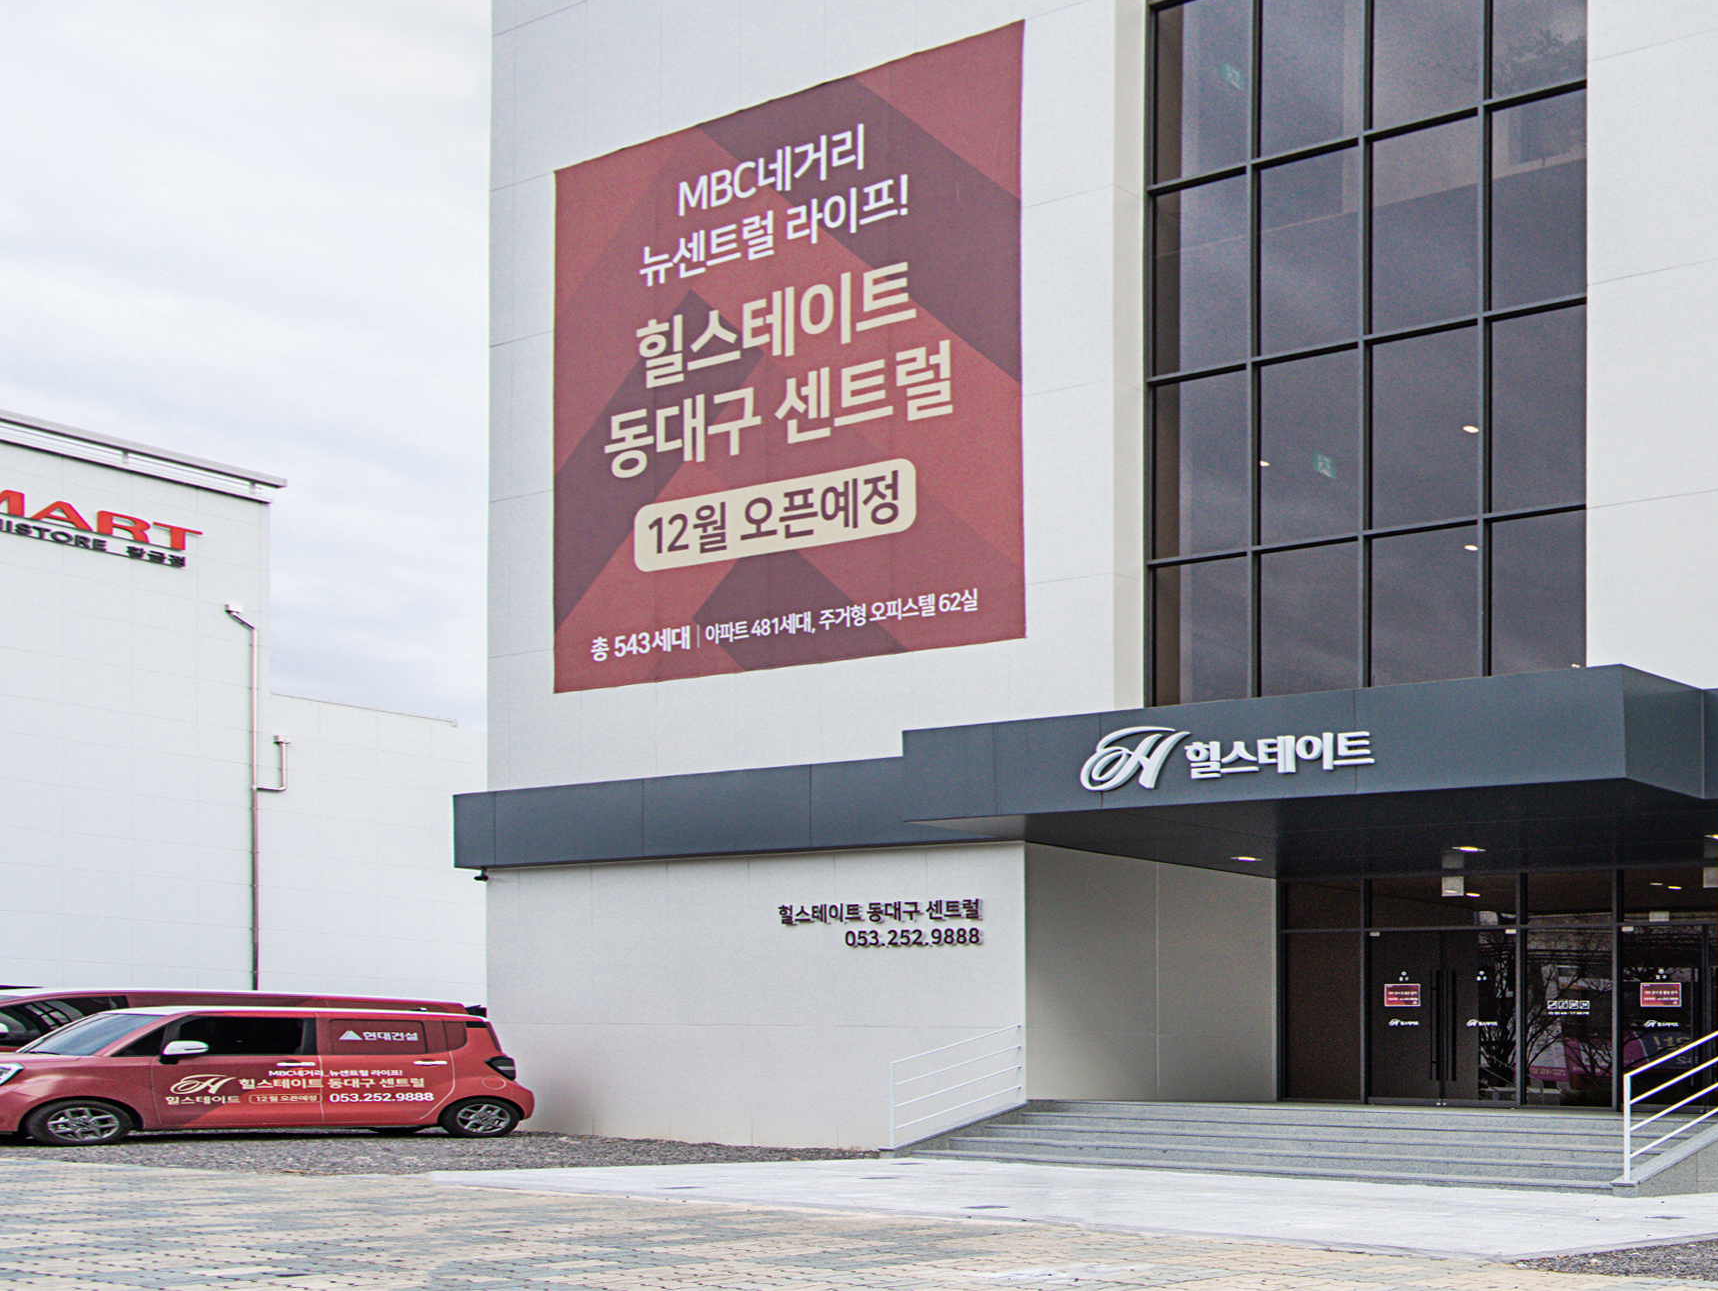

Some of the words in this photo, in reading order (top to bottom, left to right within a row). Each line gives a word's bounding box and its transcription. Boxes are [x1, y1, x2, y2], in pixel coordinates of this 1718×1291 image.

[677, 123, 865, 216] MBC네거리
[639, 210, 775, 287] 뉴센트럴
[786, 174, 909, 244] 라이프!
[635, 261, 917, 389] 힐스테이트
[603, 386, 762, 479] 동대구
[774, 339, 954, 444] 센트럴
[648, 501, 728, 555] 12월
[739, 470, 900, 542] 오픈예정
[0, 518, 107, 552] ISTORE
[590, 636, 610, 662] 총
[613, 625, 691, 658] 543세대
[705, 621, 750, 644] 아파트
[750, 611, 816, 637] 481세대,
[818, 603, 867, 631] 주거형
[869, 593, 936, 621] 오피스텔
[938, 588, 978, 613] 62실
[1184, 730, 1375, 780] 힐스테이트
[778, 903, 864, 925] 힐스테이트
[866, 900, 923, 923] 동대구
[925, 898, 983, 920] 센트럴
[844, 927, 983, 948] 053.252.9888
[362, 1031, 419, 1042] 현대건설
[165, 1095, 241, 1105] 힐스테이트
[238, 1078, 324, 1090] 힐스테이트
[327, 1078, 376, 1089] 동대구
[379, 1077, 425, 1089] 센트럴
[329, 1093, 435, 1103] 053.252.9888
